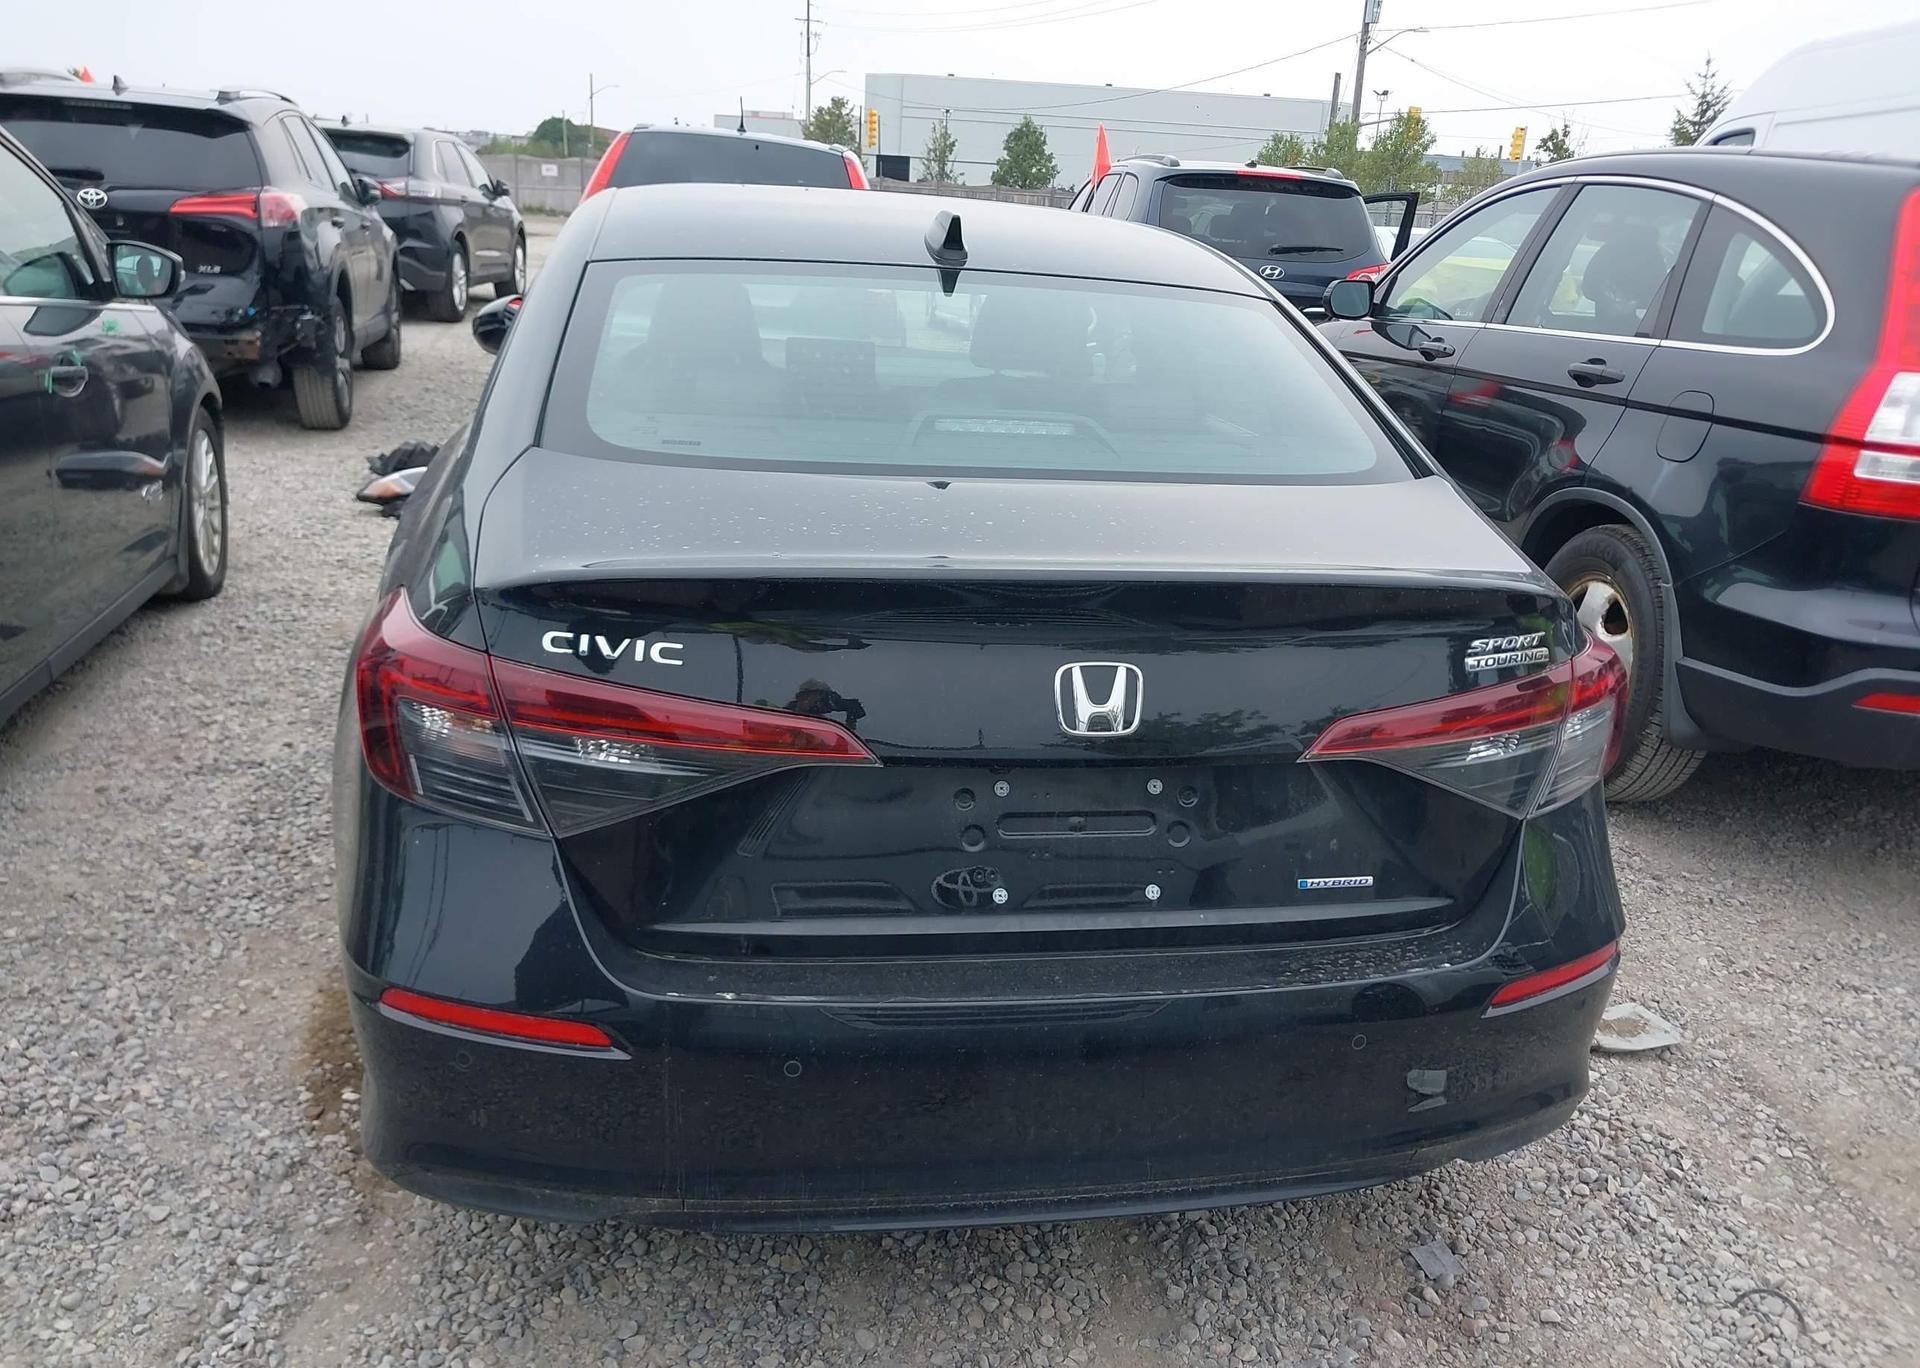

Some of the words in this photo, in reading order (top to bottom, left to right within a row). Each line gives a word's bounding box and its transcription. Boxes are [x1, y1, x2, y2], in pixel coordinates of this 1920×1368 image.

[541, 630, 684, 666] CIVIC
[1466, 631, 1546, 653] SPORT
[1472, 649, 1546, 669] TOURING
[1309, 878, 1370, 888] HYBRID
